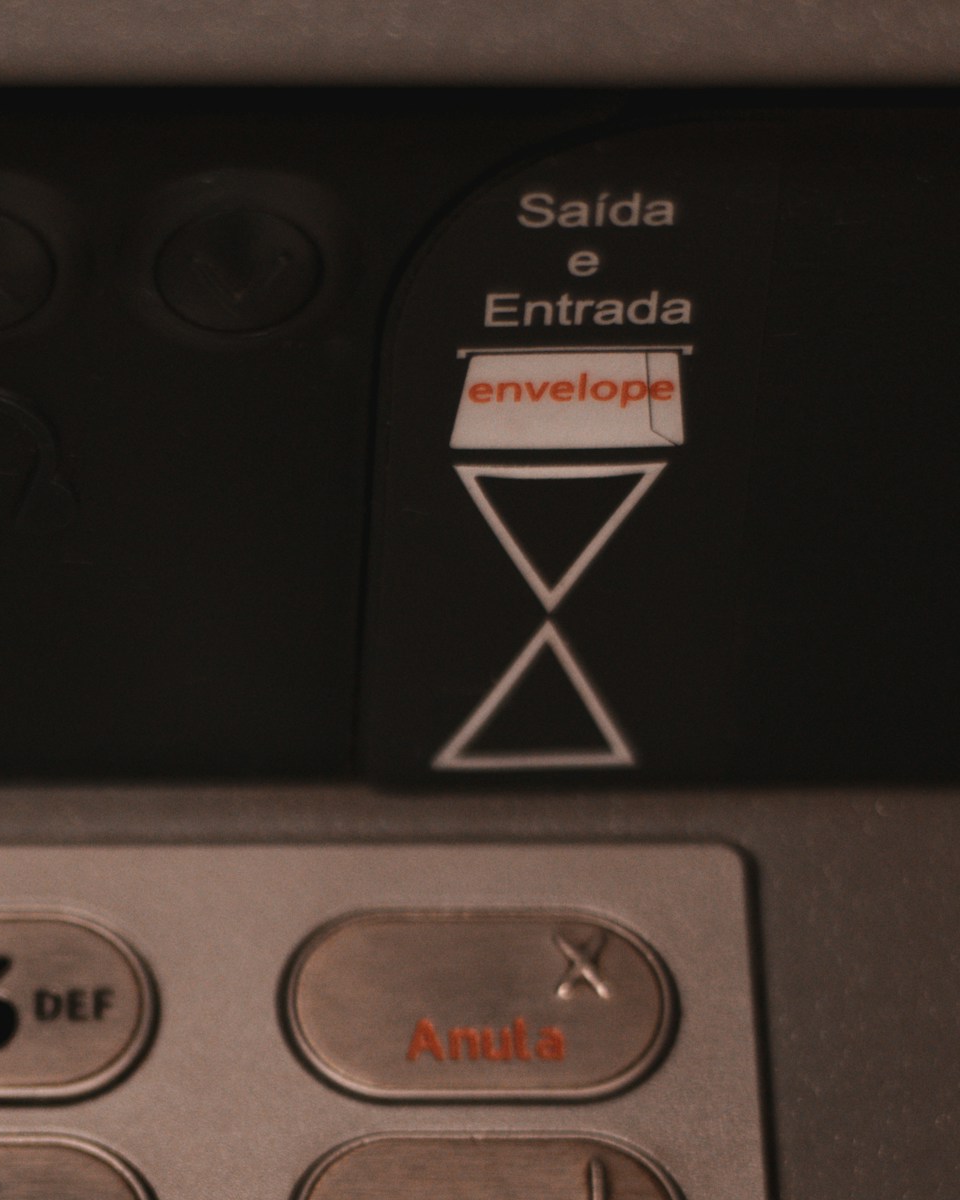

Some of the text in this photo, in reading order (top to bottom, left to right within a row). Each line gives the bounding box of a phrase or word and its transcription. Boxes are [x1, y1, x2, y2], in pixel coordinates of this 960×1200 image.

[517, 191, 676, 228] Saída
[567, 250, 600, 277] e
[483, 291, 693, 328] Entrada
[468, 373, 675, 409] envelope
[33, 988, 115, 1022] DEF
[406, 1018, 566, 1062] Anula
